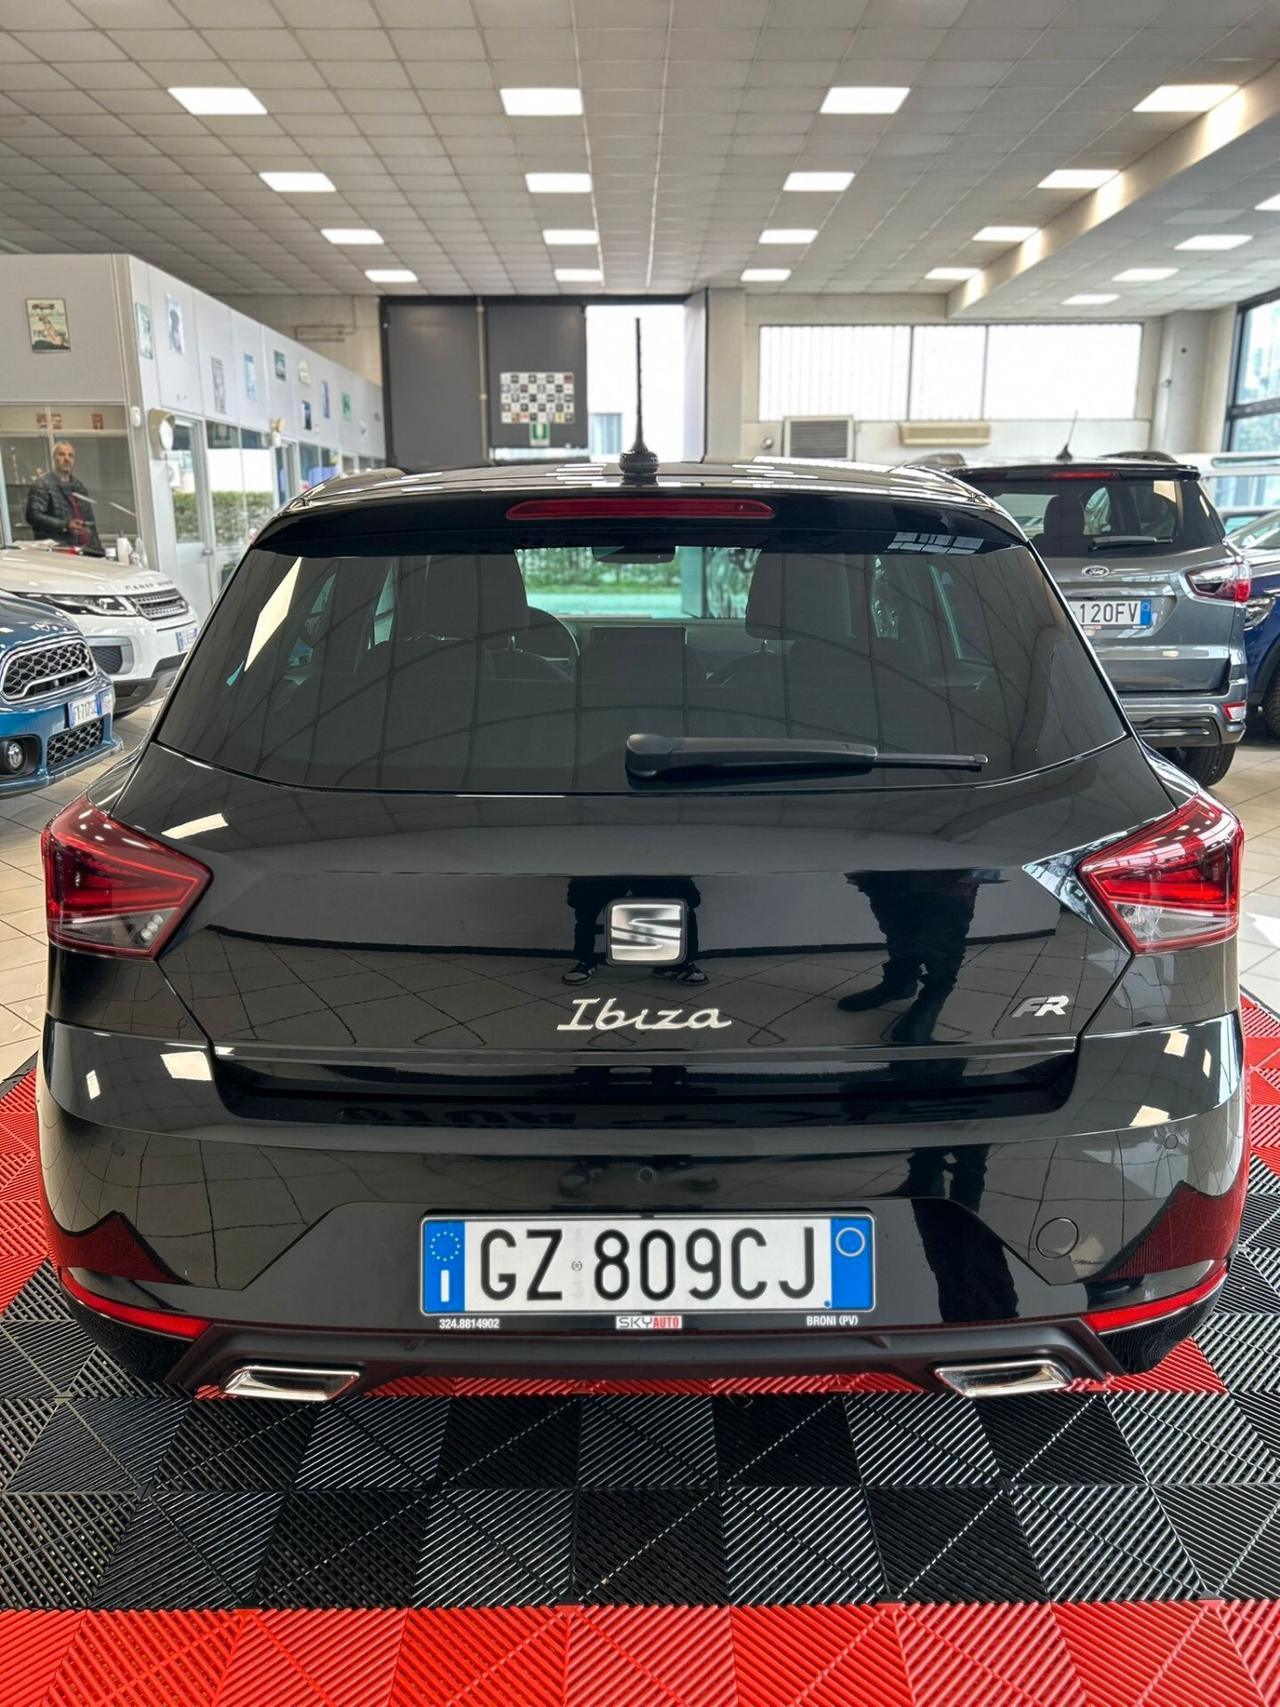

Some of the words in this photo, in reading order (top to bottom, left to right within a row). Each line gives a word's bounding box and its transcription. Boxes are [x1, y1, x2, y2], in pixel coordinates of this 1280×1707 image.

[1080, 603, 1138, 623] 120FV
[556, 998, 732, 1031] Ibiza
[1011, 995, 1069, 1018] FR
[438, 1318, 500, 1329] 324.8814902
[806, 1315, 837, 1326] BRONI
[838, 1315, 859, 1327] (PV)
